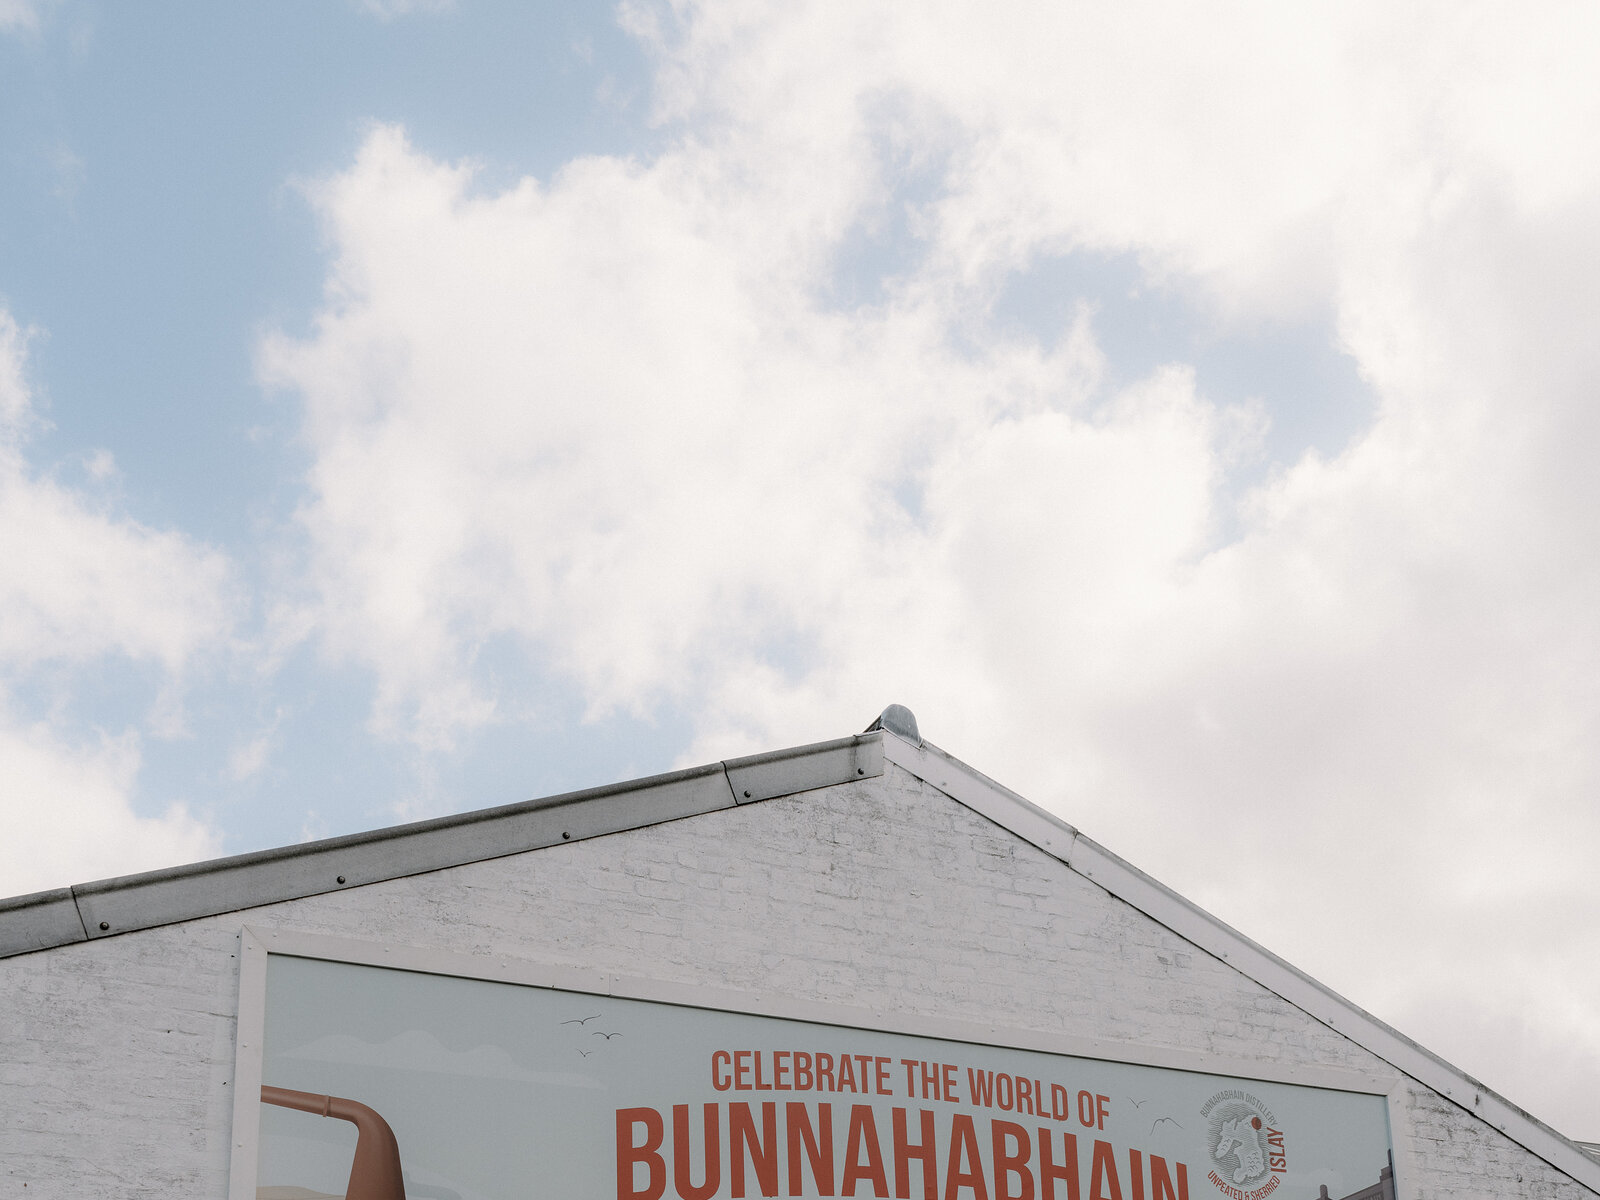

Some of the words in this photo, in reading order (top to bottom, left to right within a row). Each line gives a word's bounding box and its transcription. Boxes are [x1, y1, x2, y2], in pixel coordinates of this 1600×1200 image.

[711, 1050, 893, 1097] CELEBRATE
[900, 1059, 960, 1103] THE
[967, 1067, 1070, 1121] WORLD
[1077, 1090, 1111, 1131] OF
[1200, 1089, 1245, 1118] BUNNAHABHAIN
[1245, 1093, 1278, 1126] DISTILLERY
[1266, 1126, 1287, 1173] ISLAY
[1207, 1170, 1243, 1200] UNPEATED
